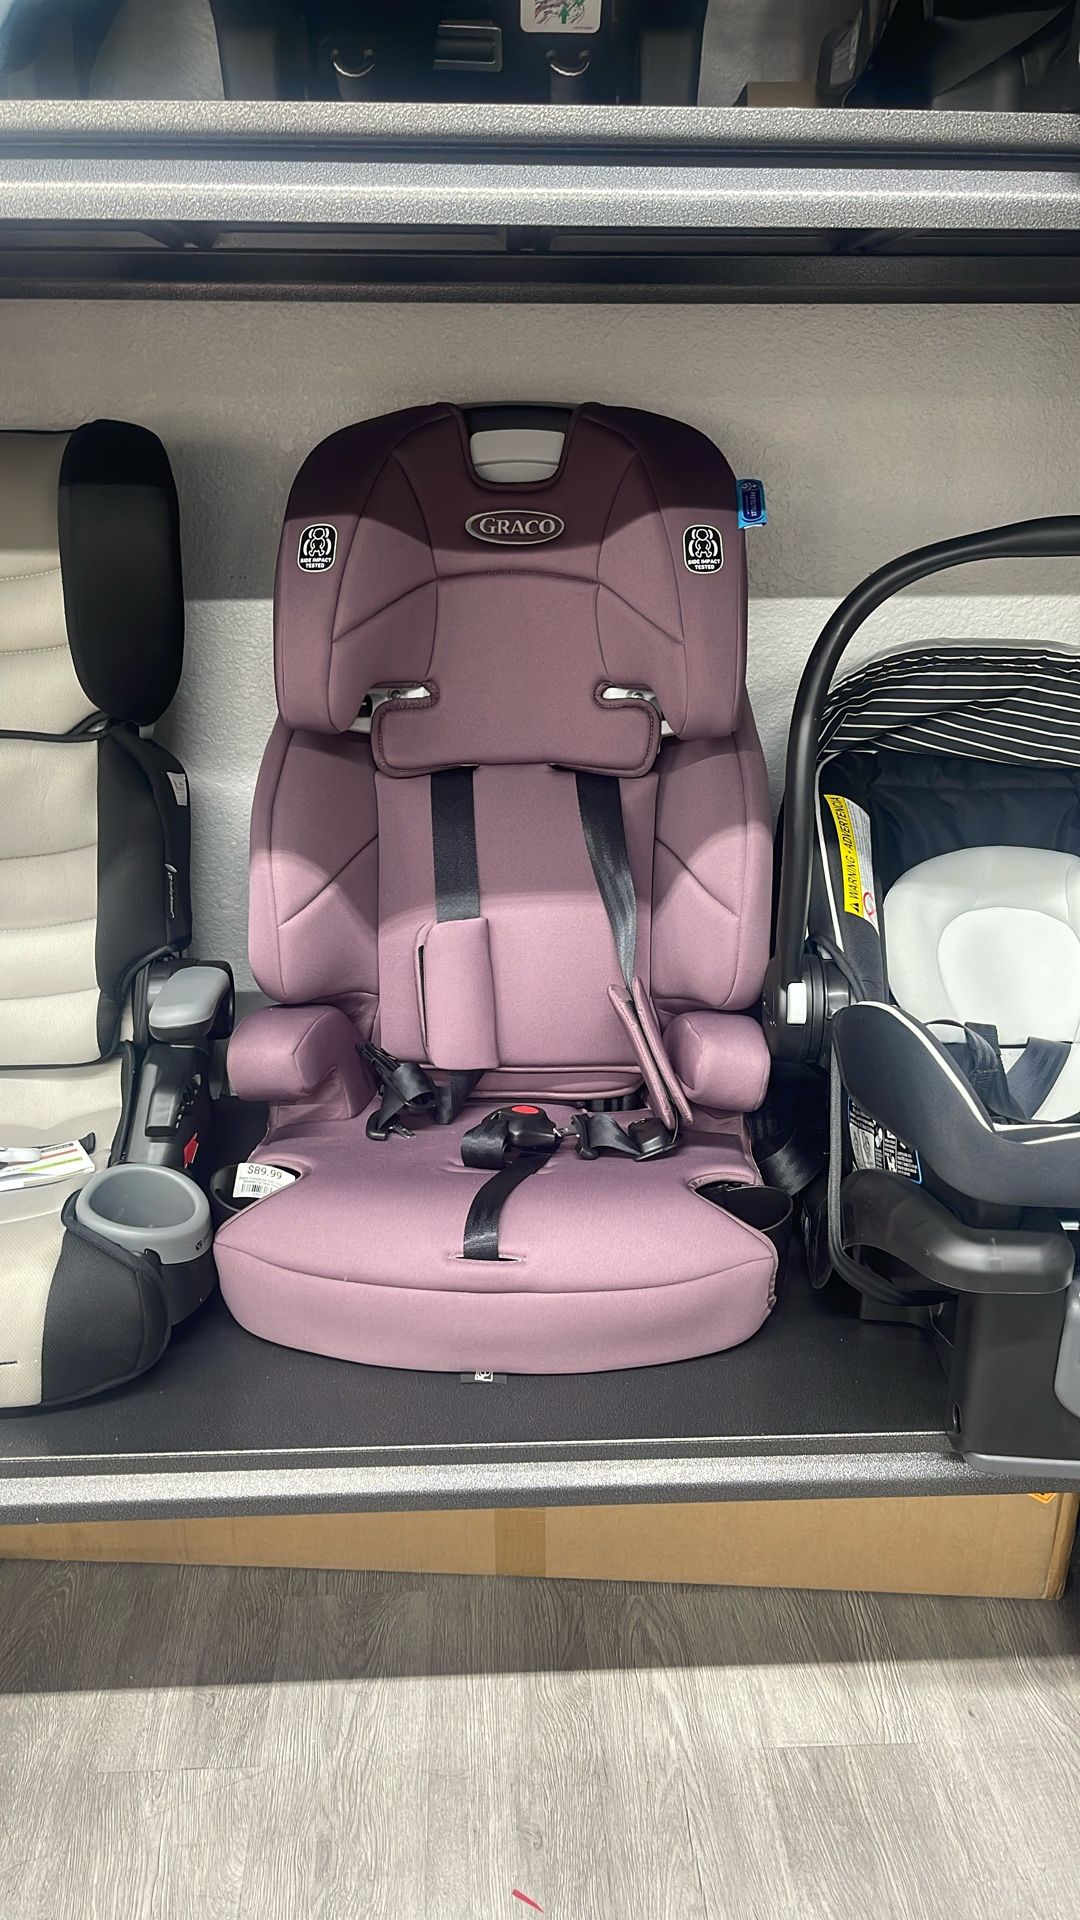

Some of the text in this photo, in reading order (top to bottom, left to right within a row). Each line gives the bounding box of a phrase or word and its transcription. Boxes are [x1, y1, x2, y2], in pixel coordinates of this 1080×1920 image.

[479, 517, 555, 535] GRACO
[829, 796, 859, 900] WARNING ADVERTENCIA
[247, 1164, 283, 1180] $89.99
